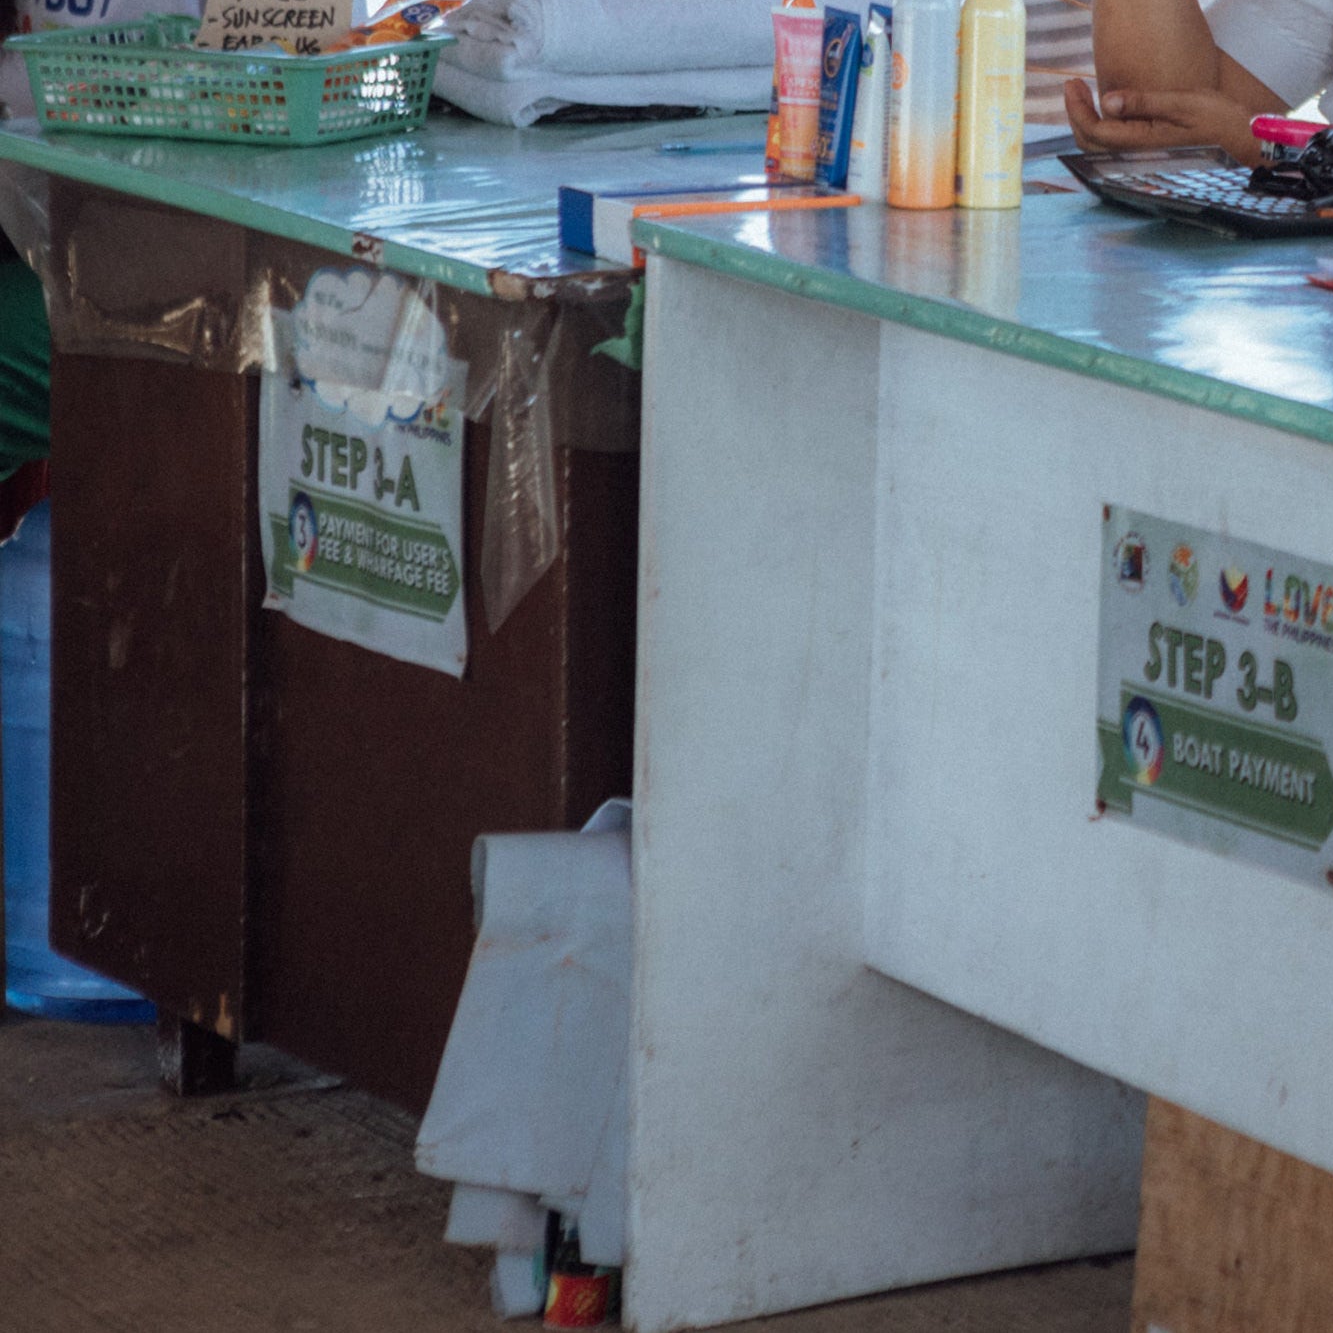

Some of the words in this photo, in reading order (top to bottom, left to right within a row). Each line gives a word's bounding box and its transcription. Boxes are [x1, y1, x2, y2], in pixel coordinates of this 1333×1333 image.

[222, 6, 335, 29] SUNSCREEN
[301, 422, 368, 490] STEP
[373, 445, 420, 512] 3-A
[318, 514, 376, 549] PAYMENT
[377, 532, 400, 559] FOR
[318, 540, 343, 563] FEE
[343, 547, 354, 566] &
[357, 549, 424, 589] WHARFAGE
[426, 568, 451, 595] FEE
[1143, 620, 1227, 700] STEP
[1236, 650, 1299, 723] 3-B
[1135, 719, 1151, 757] 4
[1172, 731, 1223, 775] BOAT
[1228, 748, 1318, 806] PAYMENT
